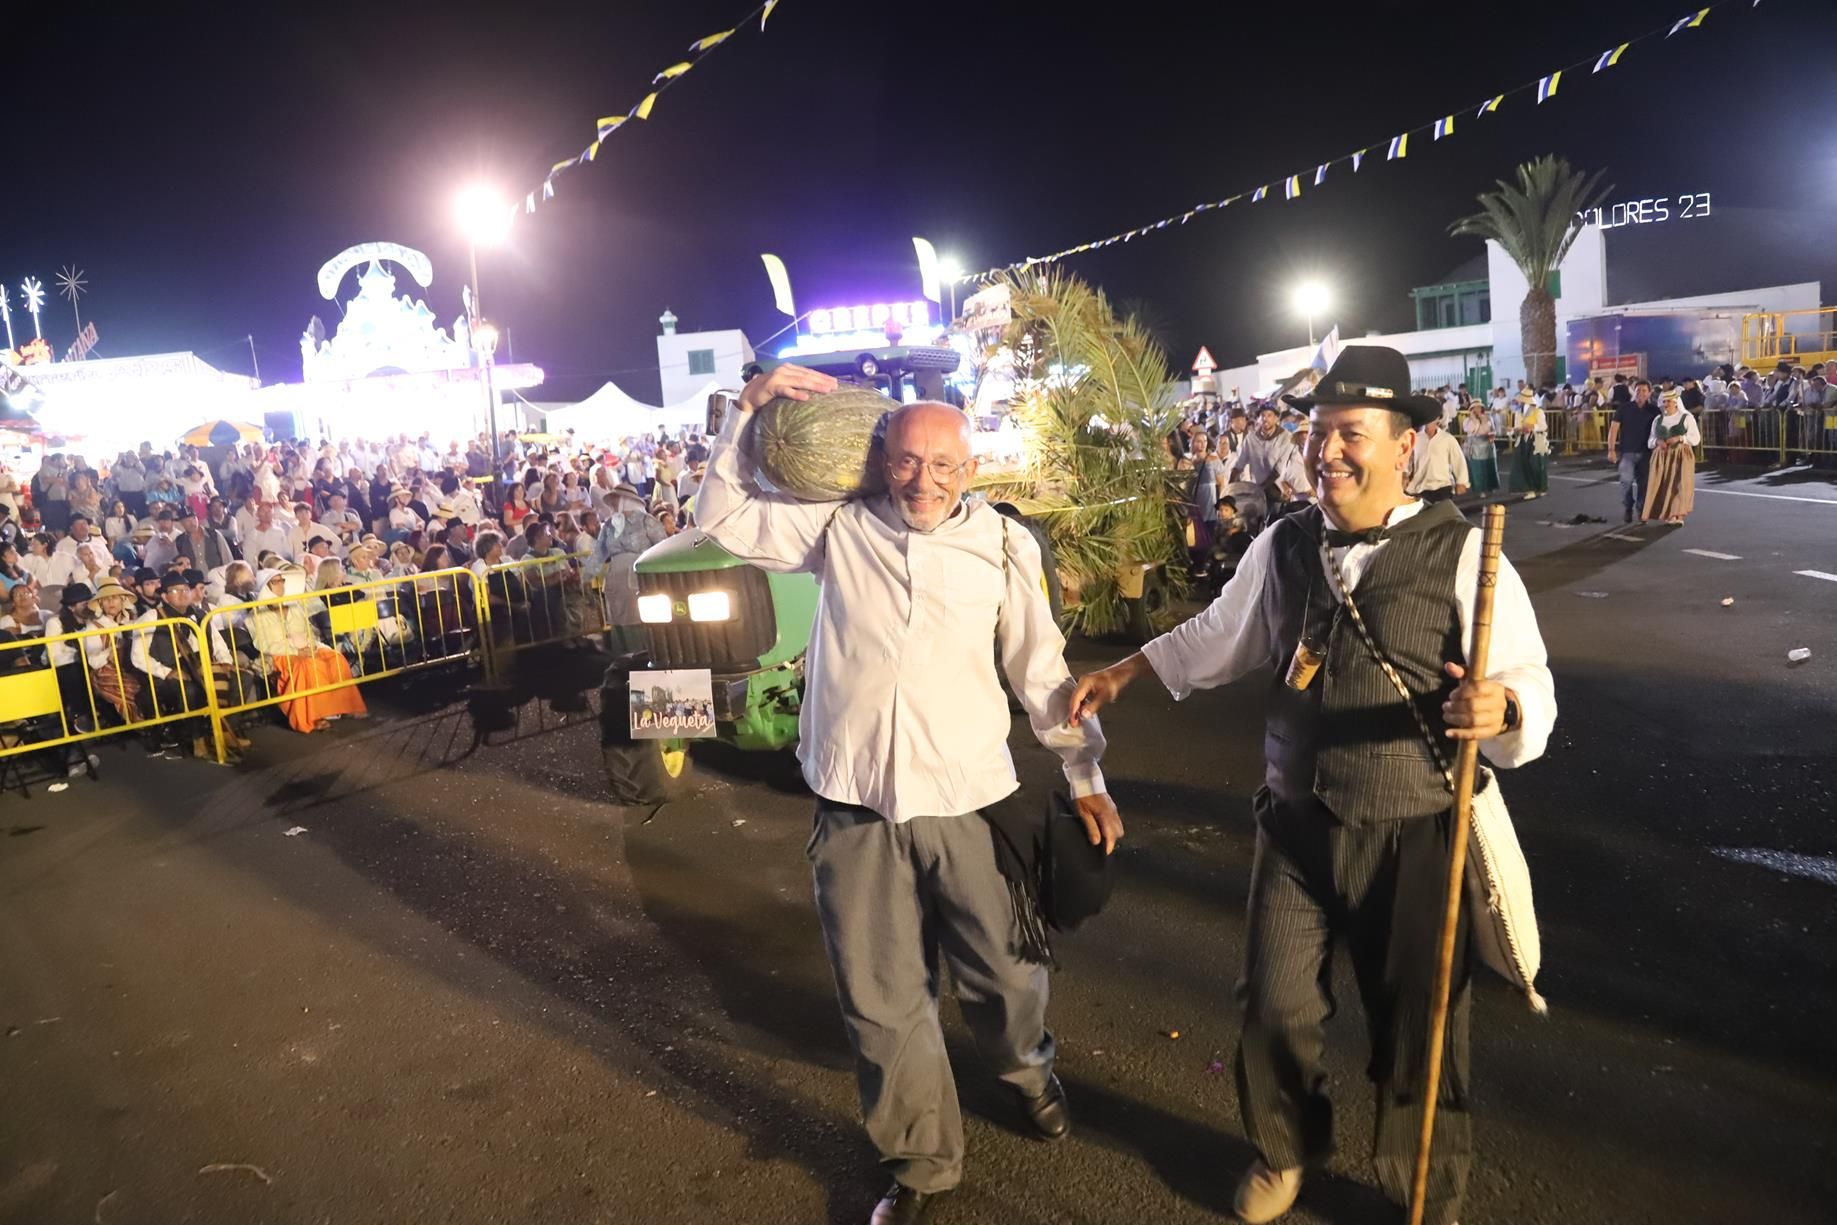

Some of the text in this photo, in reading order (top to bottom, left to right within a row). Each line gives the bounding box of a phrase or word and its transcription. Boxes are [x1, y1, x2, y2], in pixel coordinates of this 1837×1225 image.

[1678, 192, 1711, 219] 23
[633, 710, 711, 735] La Vegueta
